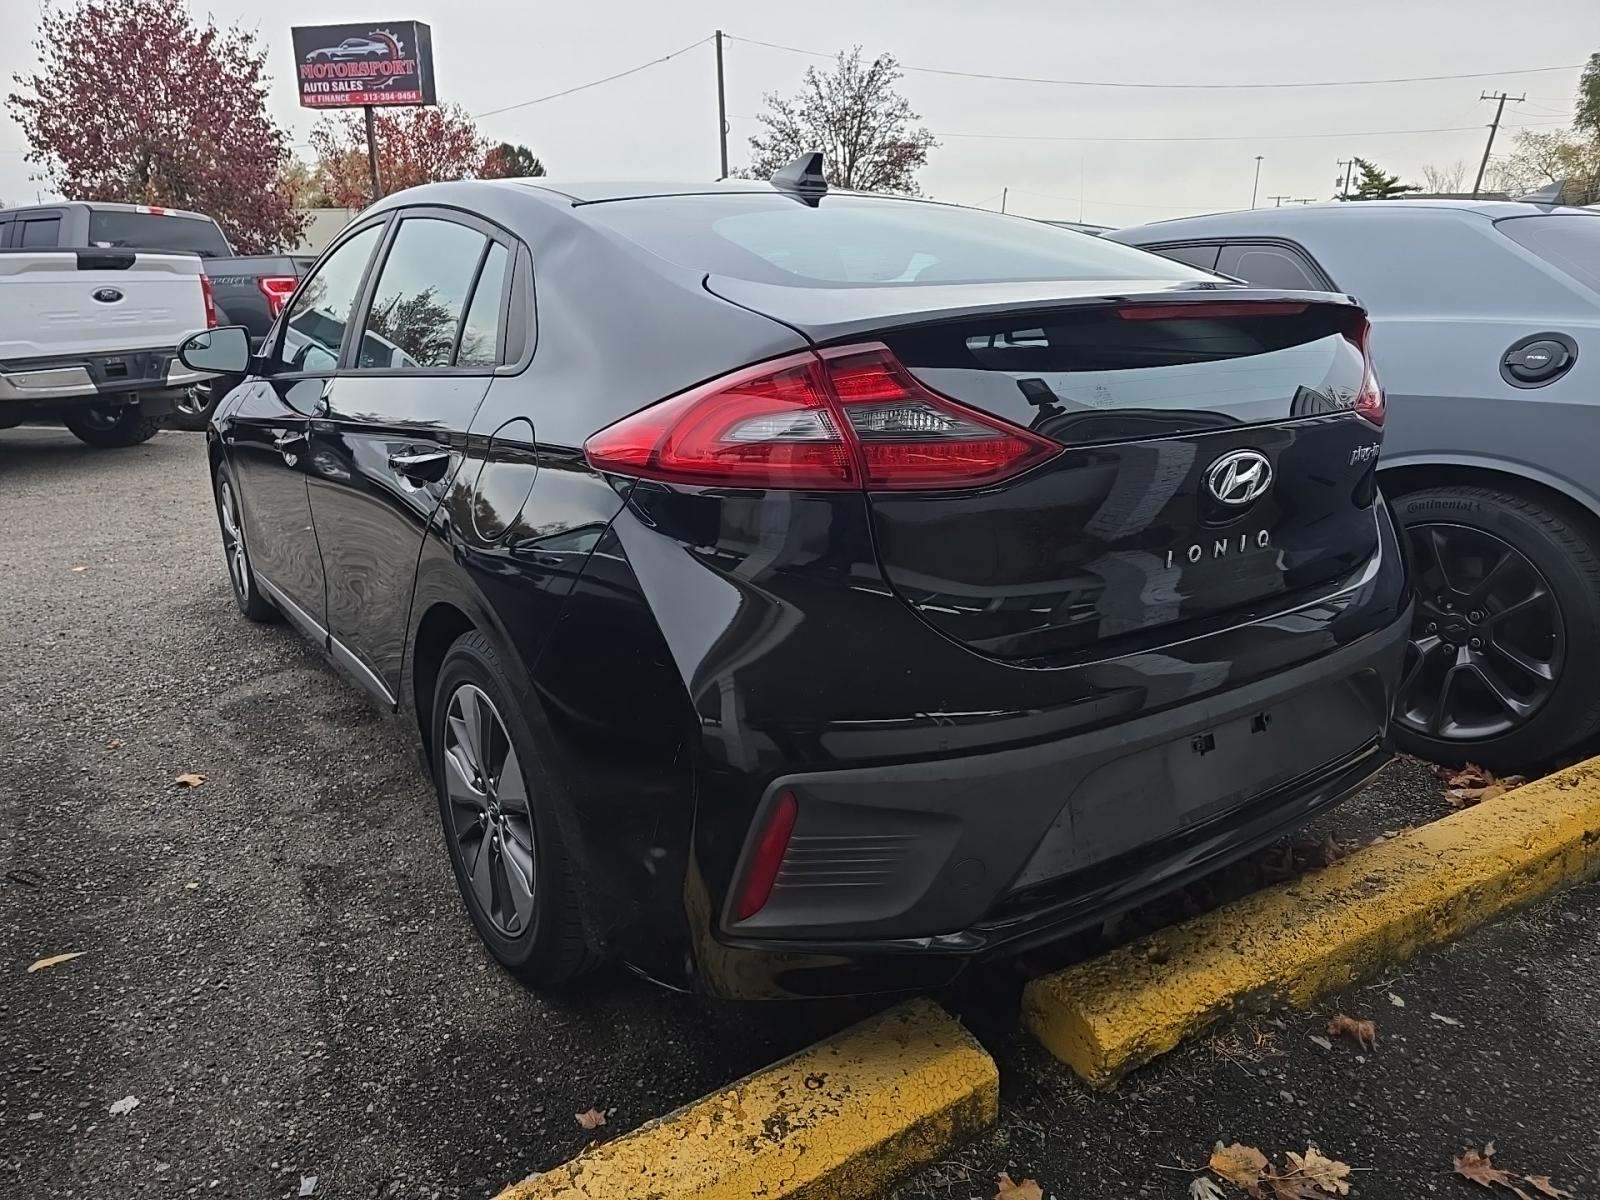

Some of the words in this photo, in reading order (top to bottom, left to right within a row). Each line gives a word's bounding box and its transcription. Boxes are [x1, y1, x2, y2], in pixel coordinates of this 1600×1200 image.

[300, 60, 416, 79] MOTORSPORT
[303, 81, 330, 93] AUTO
[332, 80, 363, 92] SALES
[303, 94, 316, 103] WE
[317, 93, 350, 103] FINANCE
[1164, 529, 1270, 568] IONIQ
